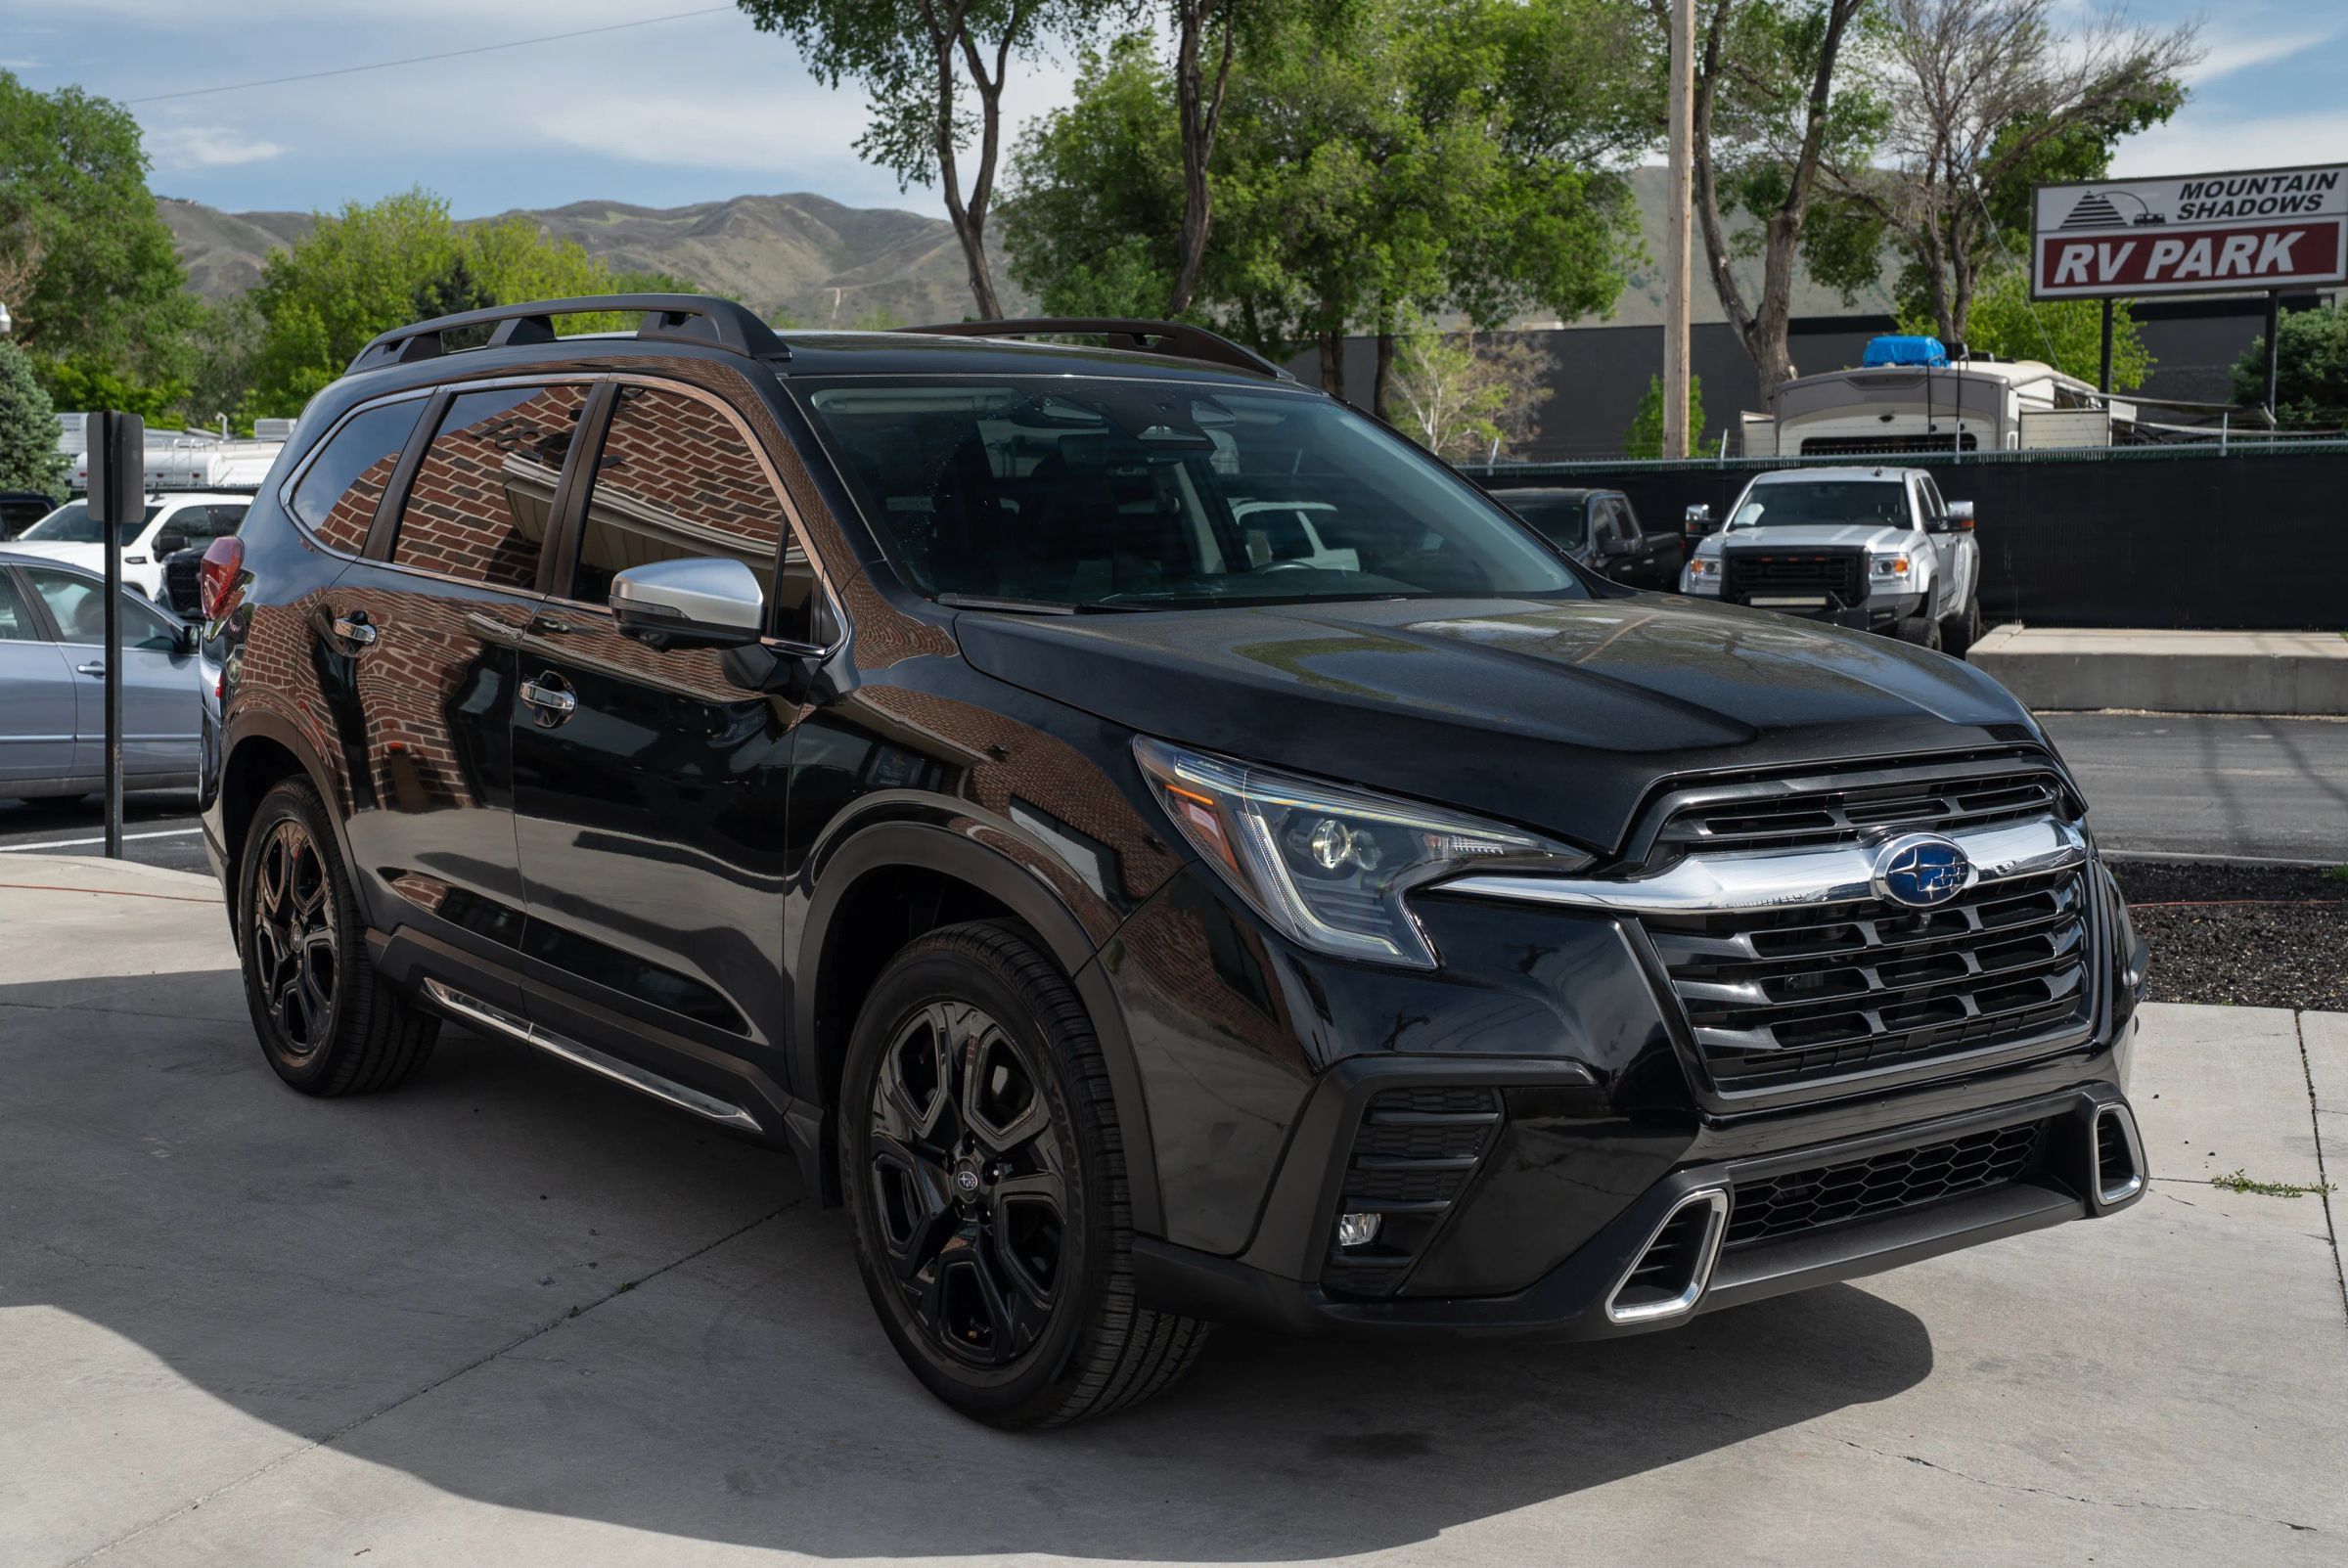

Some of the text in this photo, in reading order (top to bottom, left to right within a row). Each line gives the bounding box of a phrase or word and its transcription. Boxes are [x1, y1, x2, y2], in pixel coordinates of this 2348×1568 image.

[2179, 172, 2339, 201] MOUNTAIN
[2177, 194, 2325, 221] SHADOWS
[2053, 231, 2306, 284] RV PARK
